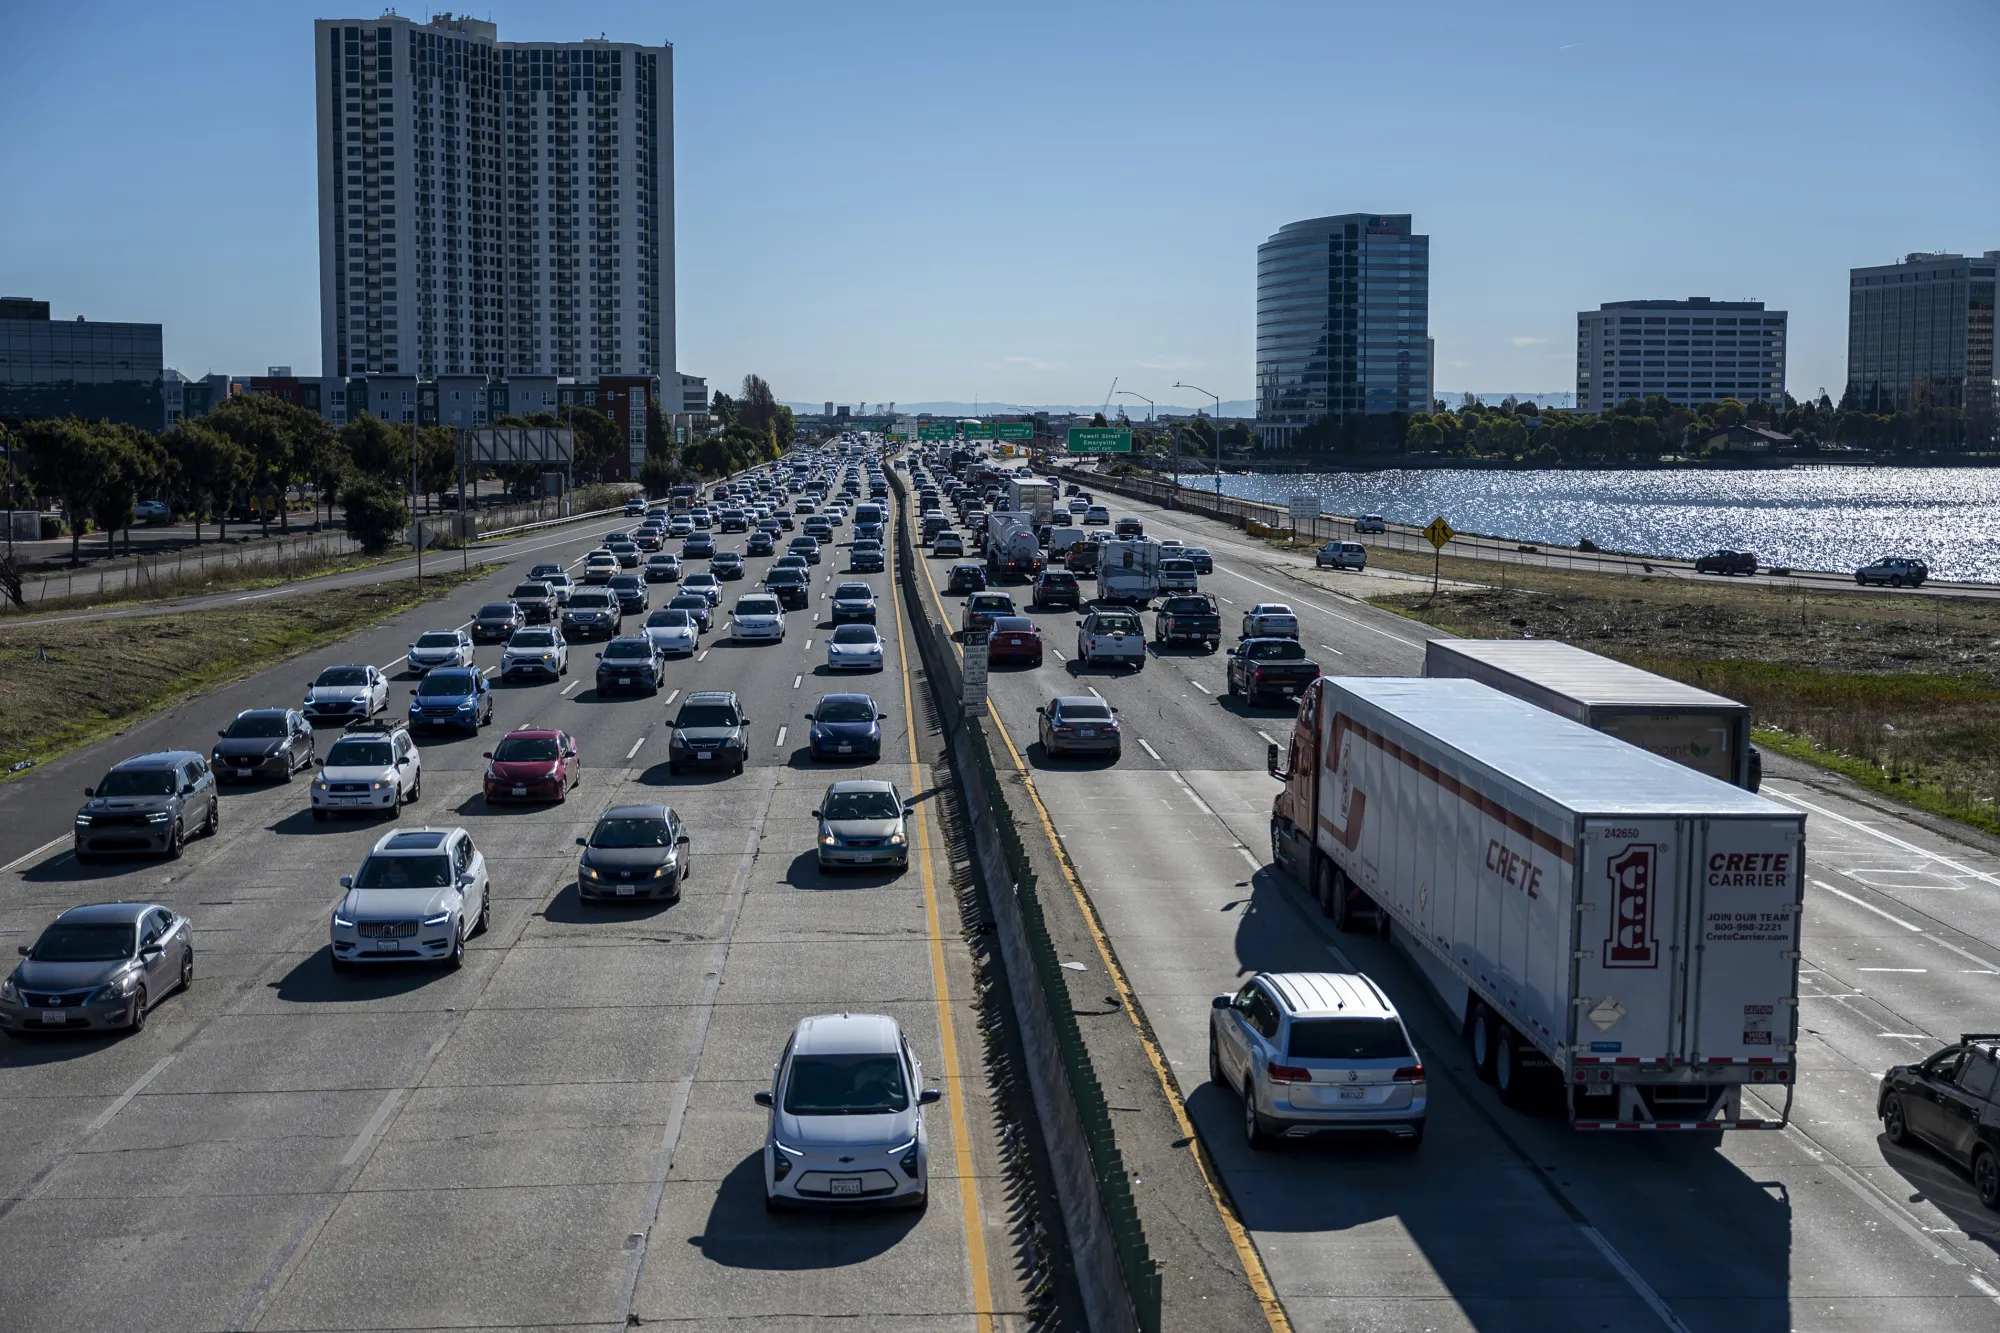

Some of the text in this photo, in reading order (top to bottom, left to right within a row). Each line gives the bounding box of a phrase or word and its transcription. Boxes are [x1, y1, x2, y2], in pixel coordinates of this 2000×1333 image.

[1604, 828, 1640, 839] 242650
[1708, 853, 1790, 872] CRETE
[1486, 838, 1543, 901] CRETE
[1708, 873, 1787, 887] CARRIER
[1706, 913, 1790, 922] JOIN OUR TEAM
[1714, 923, 1782, 932] 800-998-2221
[1706, 933, 1789, 942] CreteCarrier.com
[1745, 1006, 1772, 1014] CAUTION
